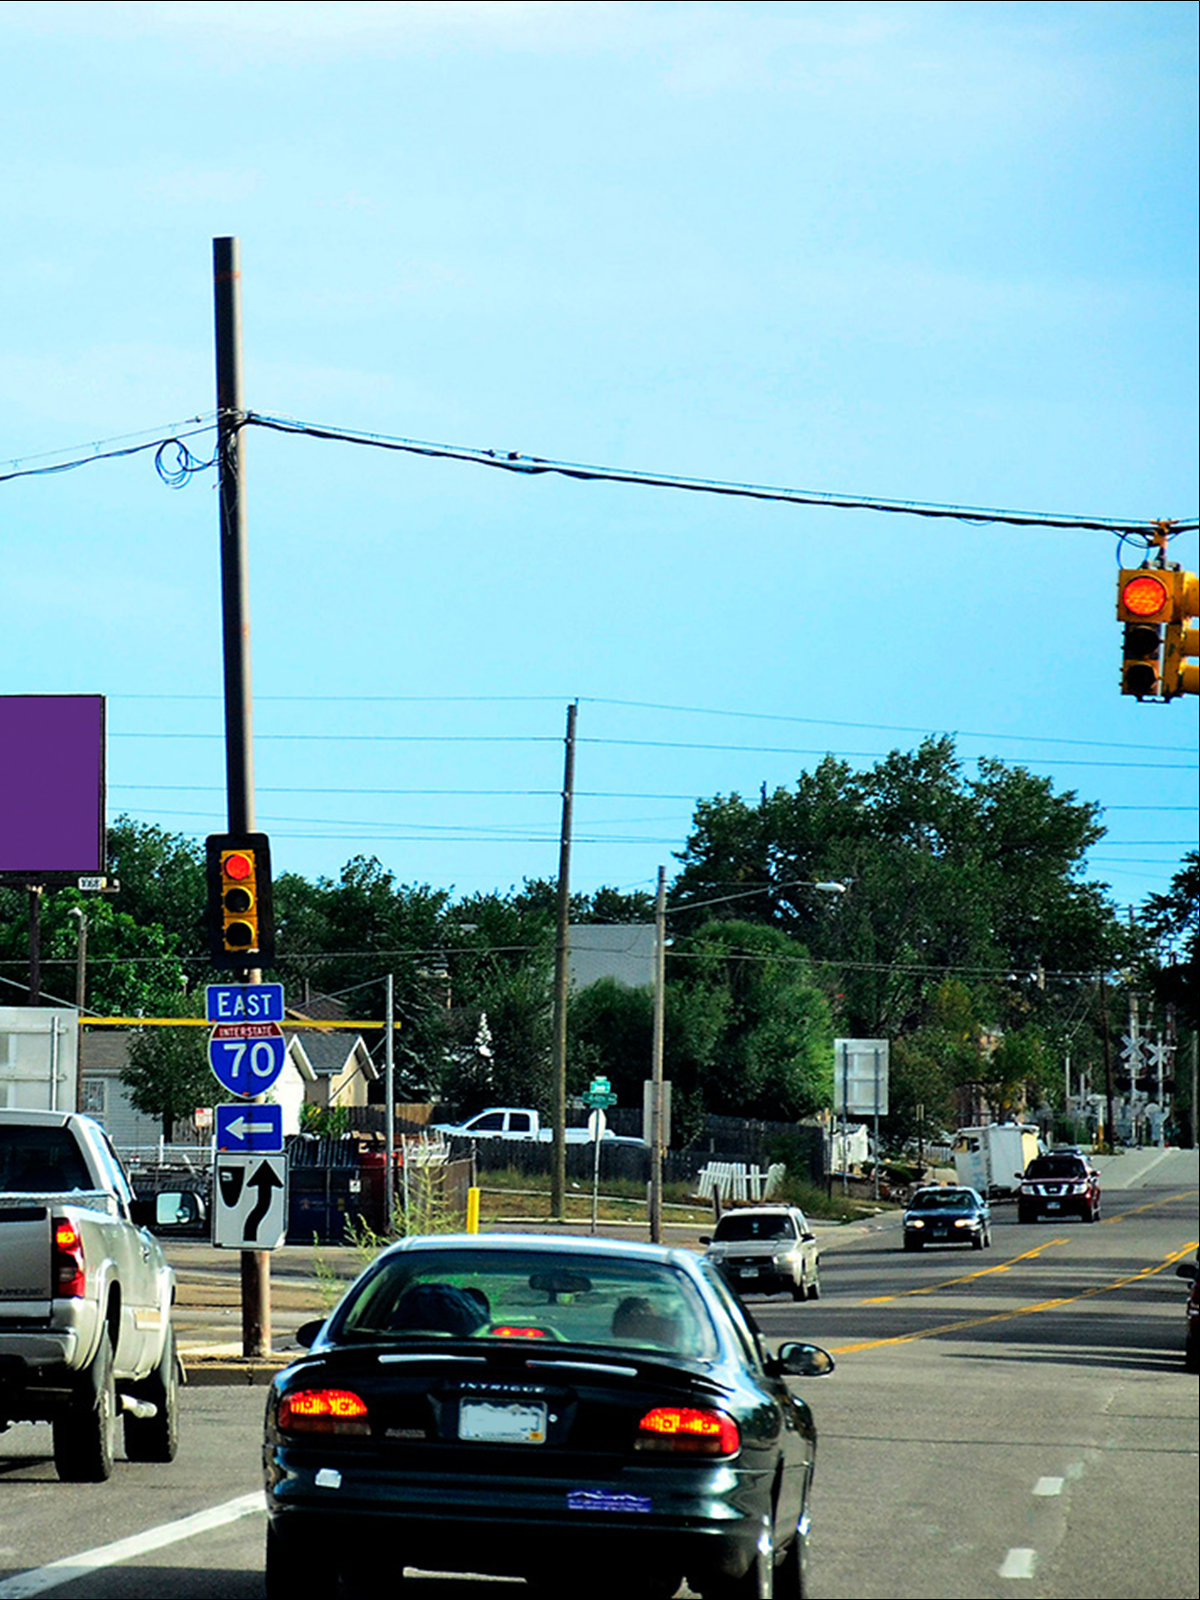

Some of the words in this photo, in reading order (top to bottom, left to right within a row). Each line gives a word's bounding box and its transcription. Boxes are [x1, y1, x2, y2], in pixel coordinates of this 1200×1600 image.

[218, 992, 272, 1016] EAST
[219, 1026, 274, 1036] INTERSTATE
[223, 1041, 275, 1078] 70
[460, 1382, 544, 1393] INTRIGUE
